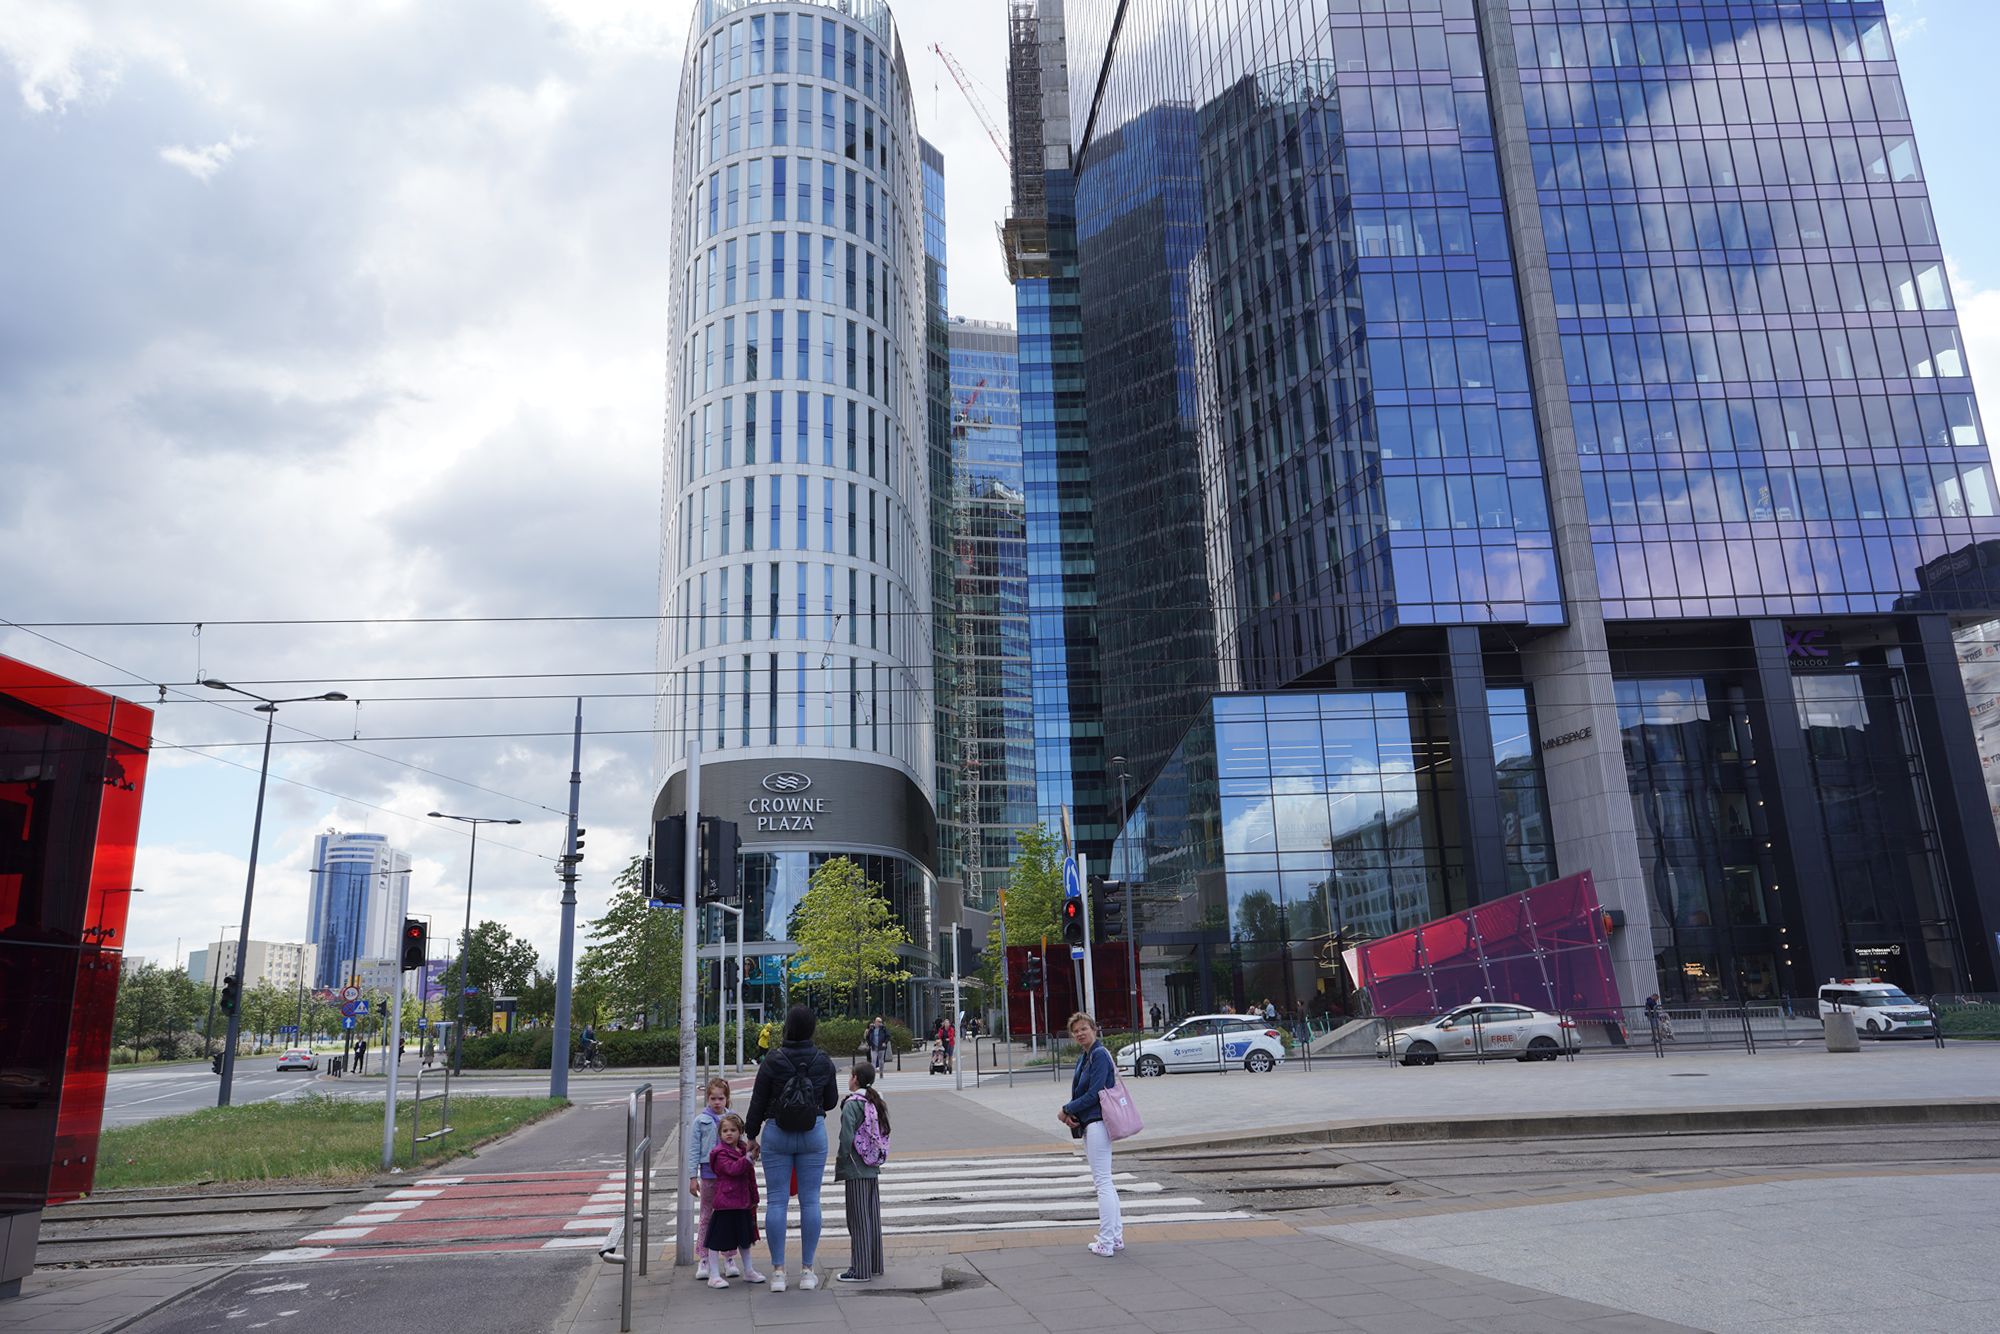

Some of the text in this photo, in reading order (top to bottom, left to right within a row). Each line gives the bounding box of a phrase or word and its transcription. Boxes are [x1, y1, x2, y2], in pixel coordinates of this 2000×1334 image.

[1542, 726, 1591, 750] MINDSPACE
[749, 797, 824, 813] CROWNE
[758, 816, 814, 831] PLAZA
[1491, 1034, 1514, 1042] FREE
